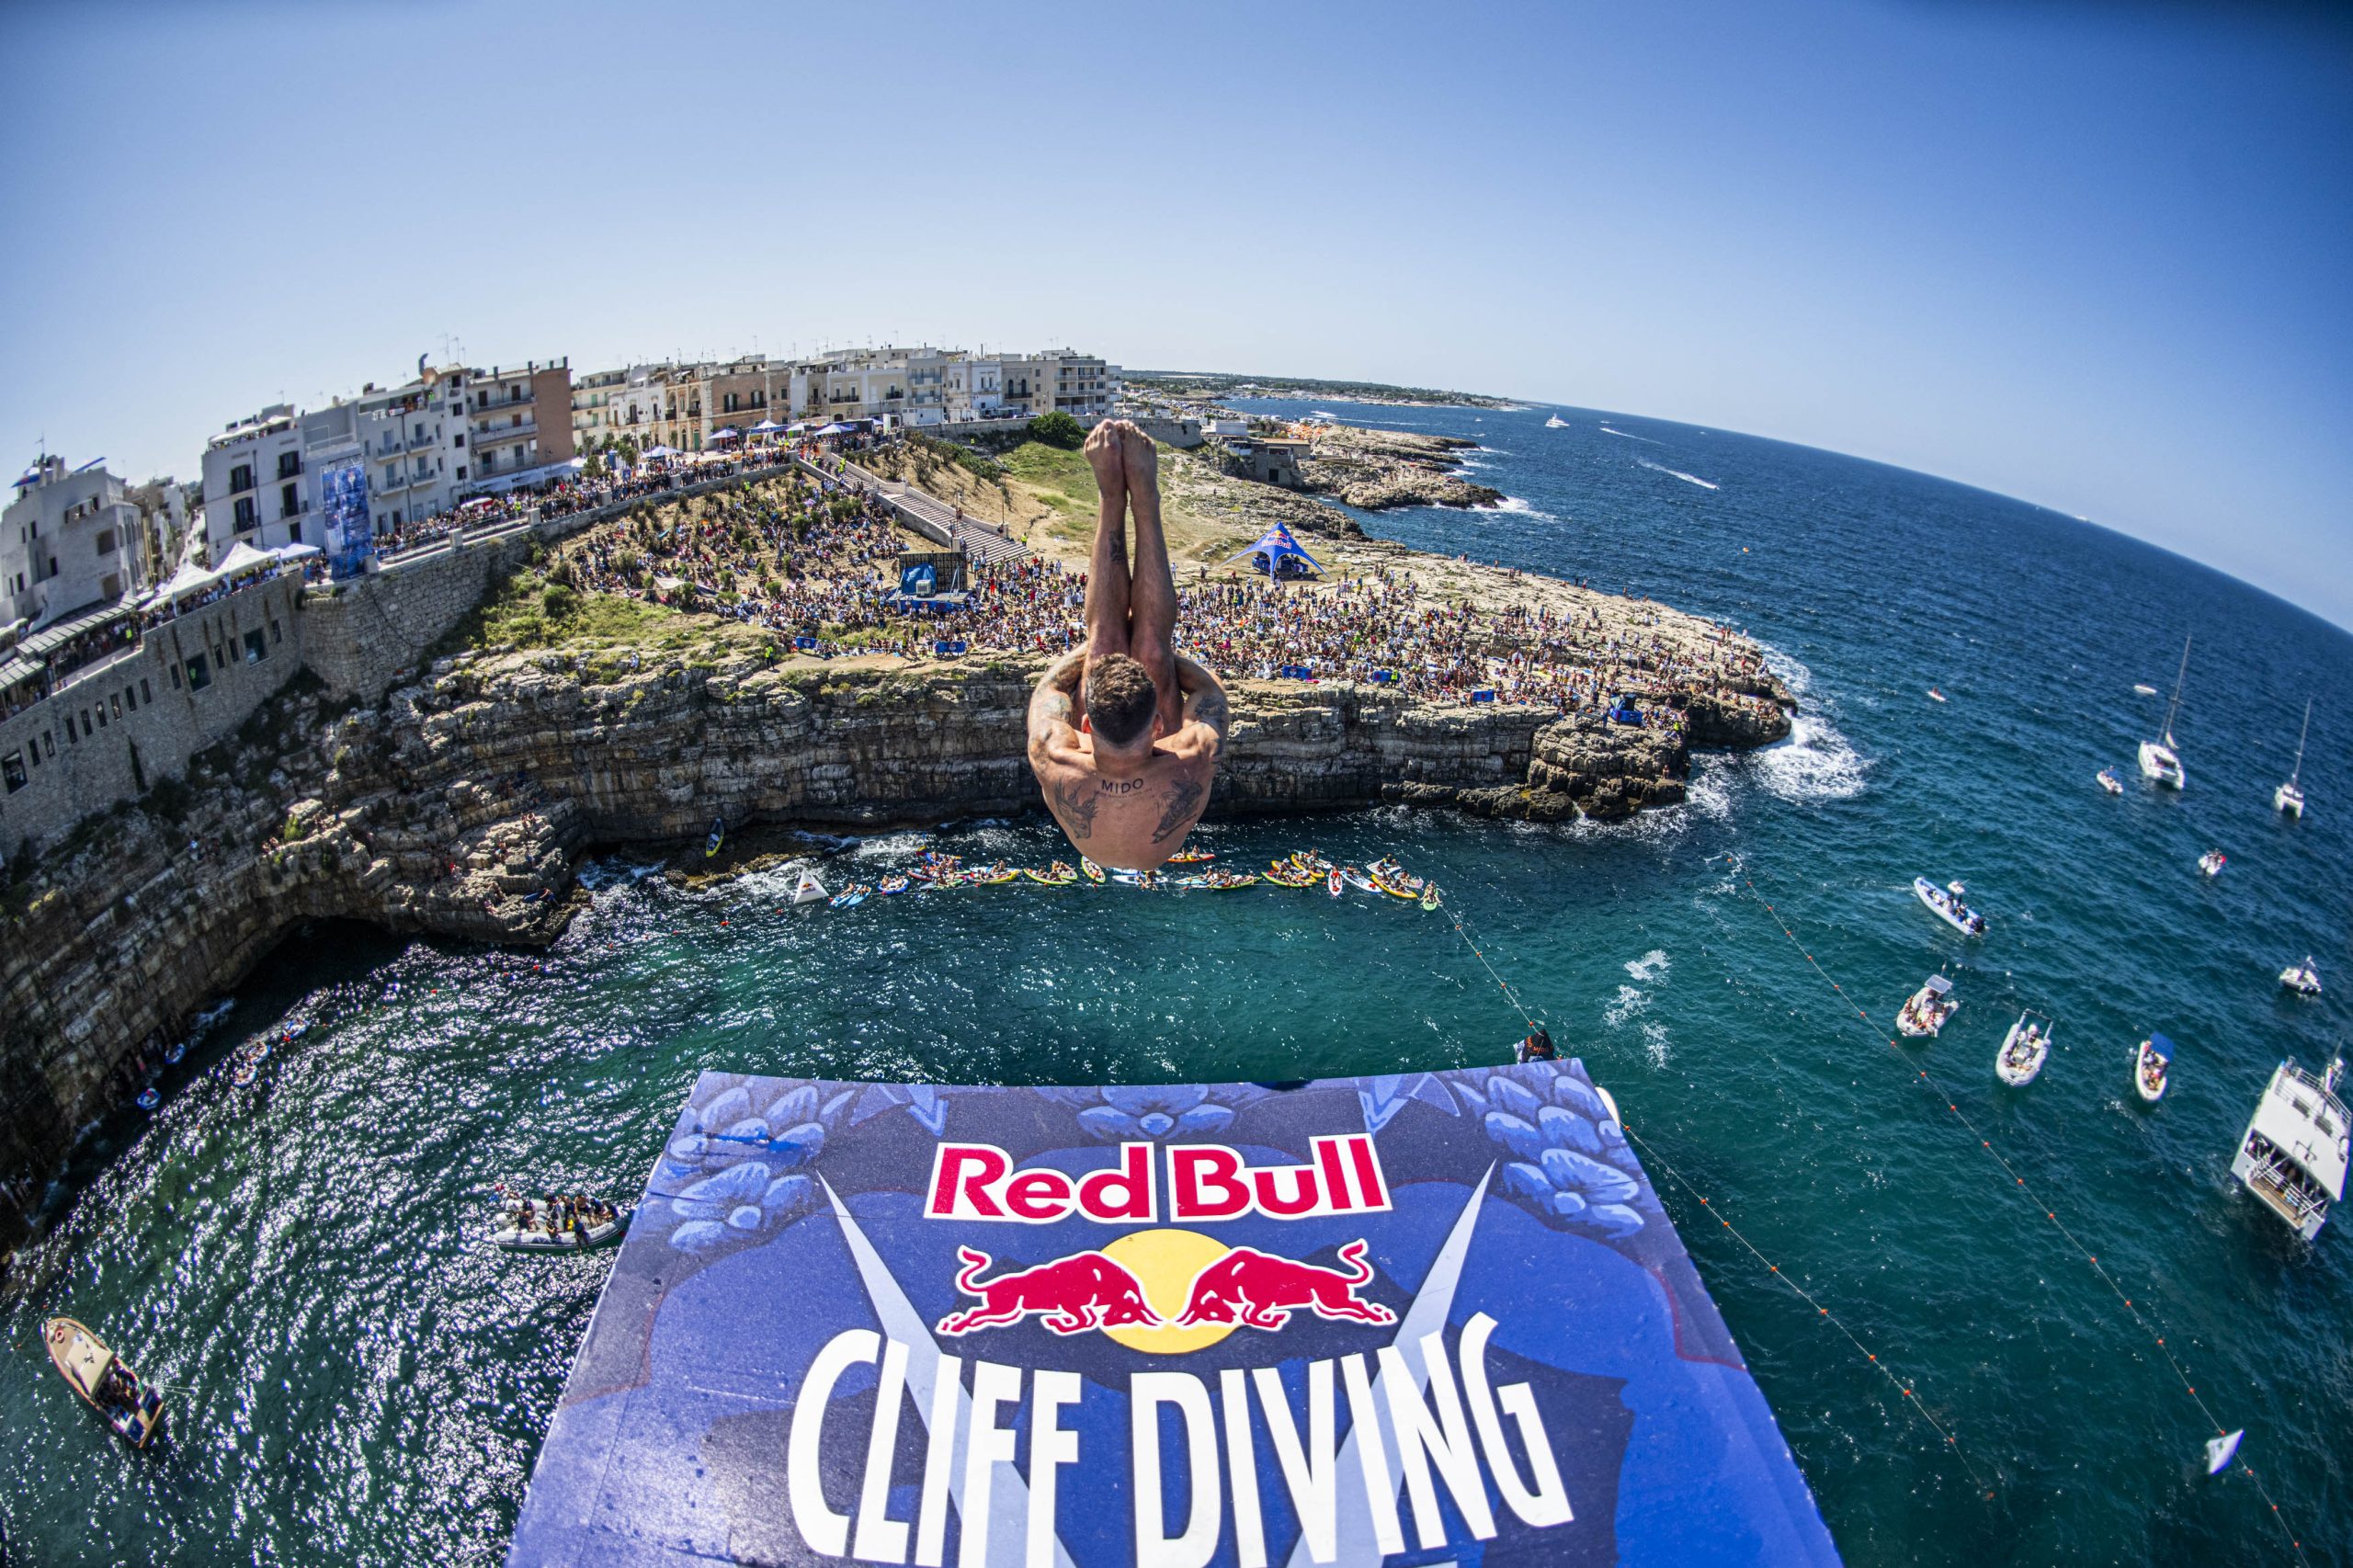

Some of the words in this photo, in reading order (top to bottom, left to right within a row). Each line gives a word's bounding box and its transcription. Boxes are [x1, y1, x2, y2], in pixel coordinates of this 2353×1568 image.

[1101, 778, 1144, 793] MIDO
[930, 1144, 1152, 1220] Red
[1172, 1137, 1386, 1221] Bull
[789, 1329, 1081, 1568] CLIFF
[1131, 1312, 1574, 1568] DIVING
